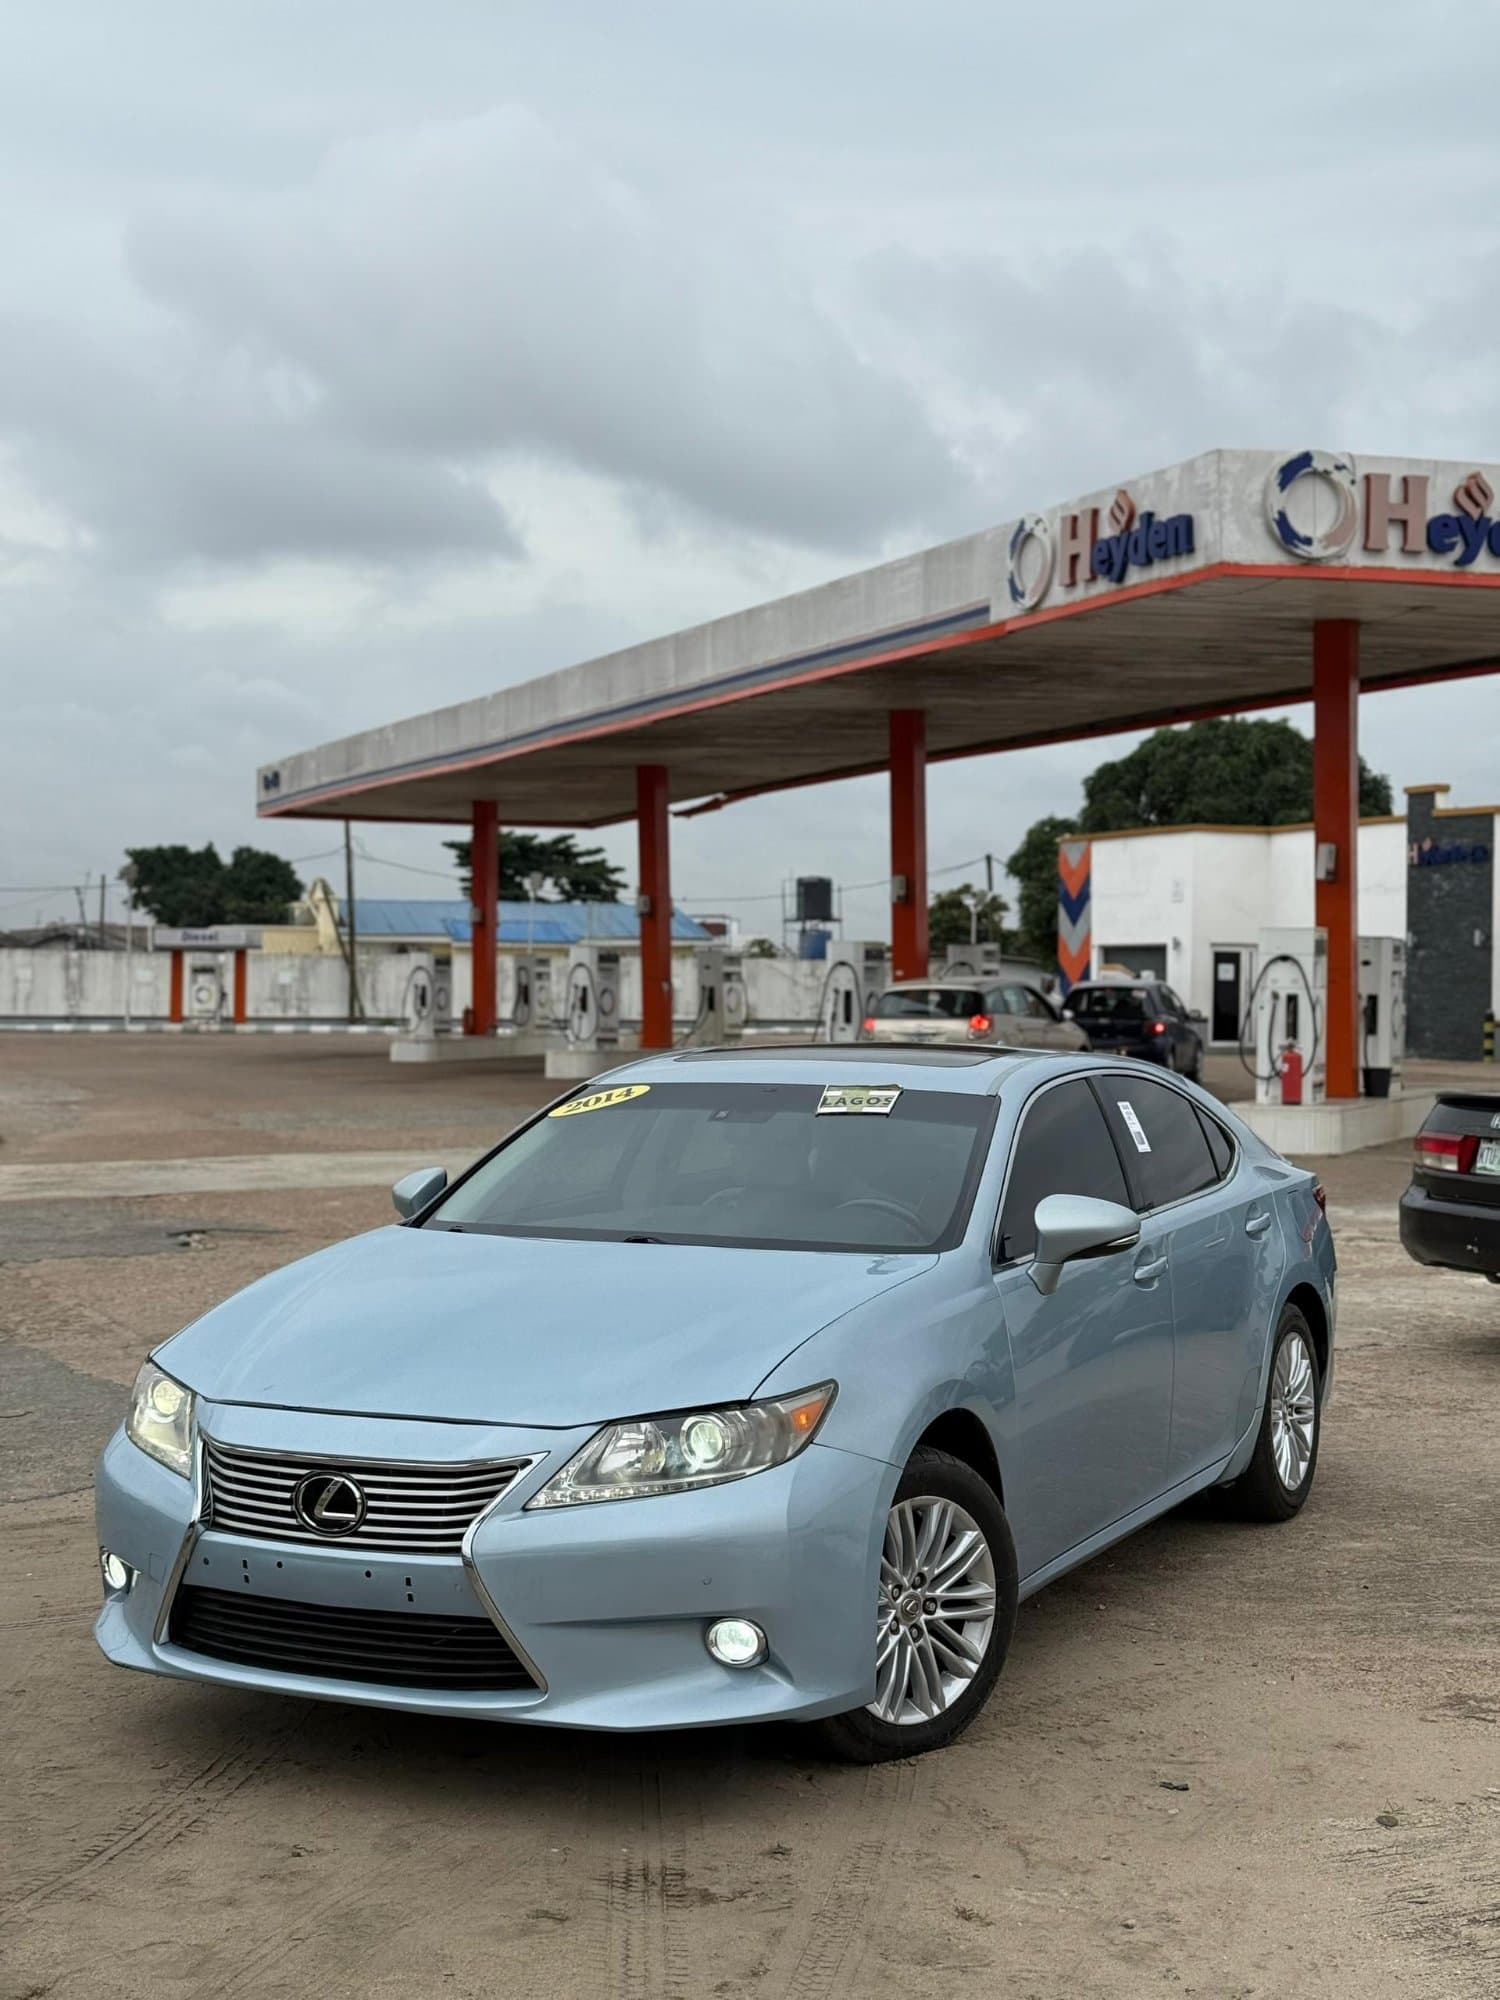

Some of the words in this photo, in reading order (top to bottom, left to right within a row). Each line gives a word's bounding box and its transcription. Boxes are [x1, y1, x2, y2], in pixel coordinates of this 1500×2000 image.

[1059, 507, 1195, 587] Heyden
[563, 1088, 635, 1113] 2014
[821, 1096, 895, 1106] LAGOS
